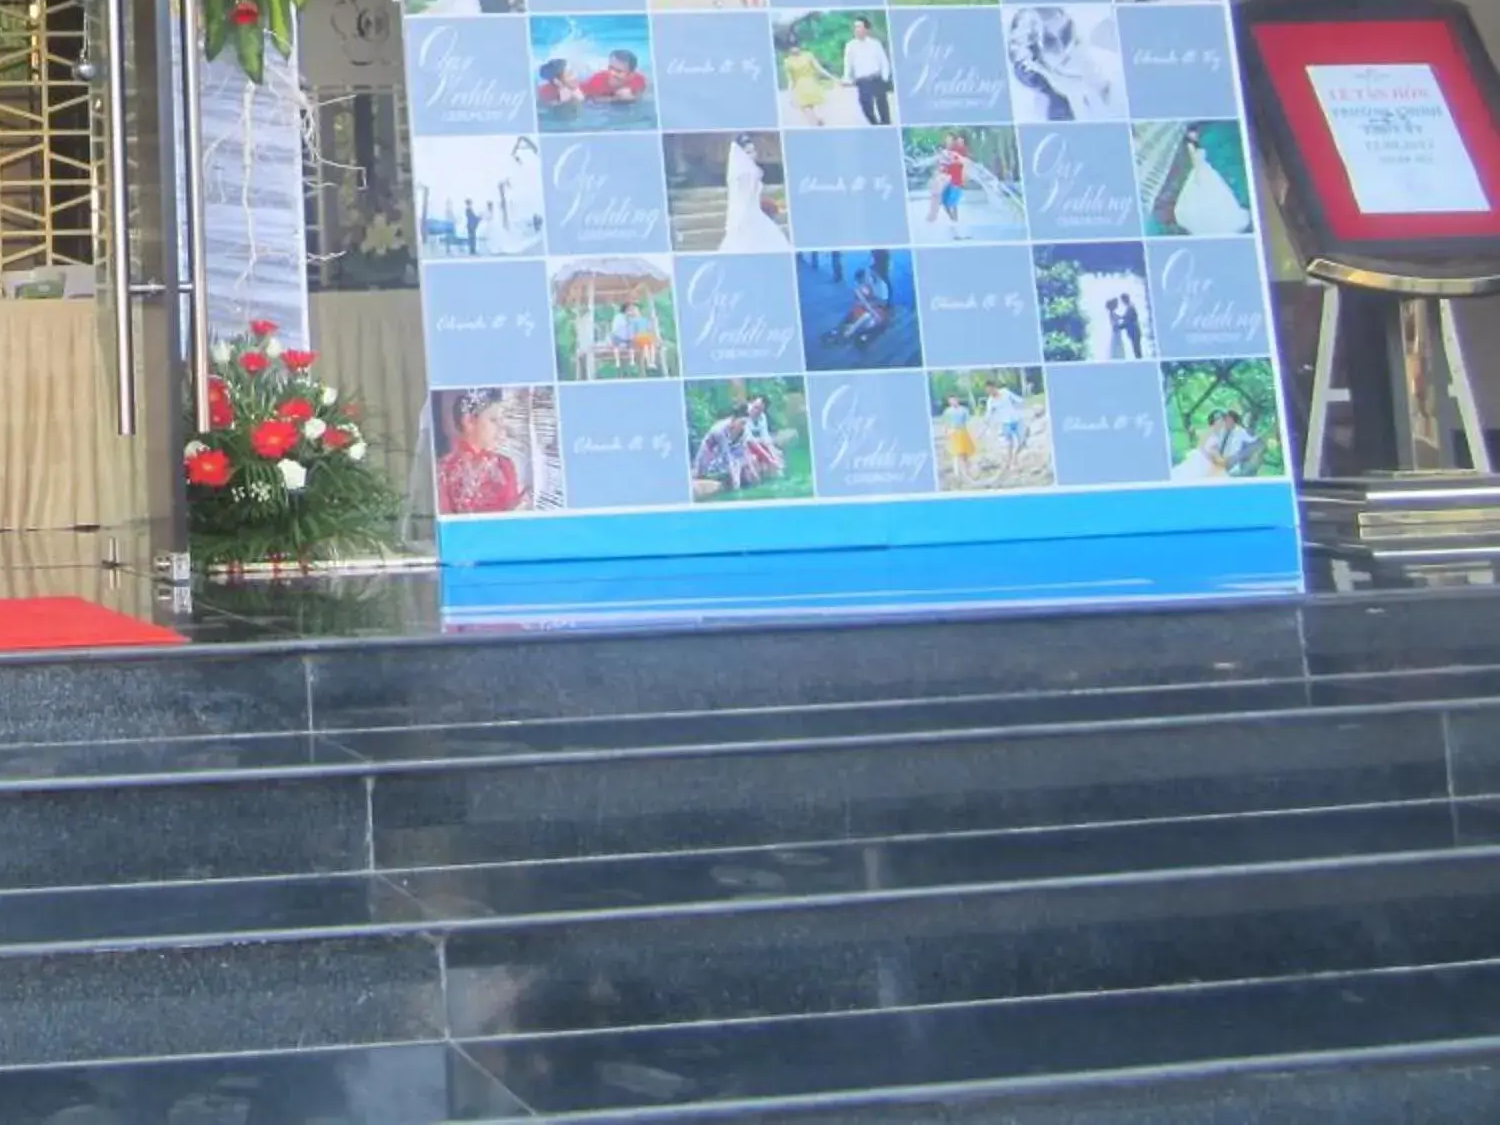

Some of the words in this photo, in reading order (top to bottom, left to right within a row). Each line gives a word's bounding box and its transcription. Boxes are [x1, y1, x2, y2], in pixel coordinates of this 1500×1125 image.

[418, 24, 476, 72] Our
[902, 14, 956, 61] Our
[425, 71, 528, 121] Wedding
[909, 60, 1006, 109] Wedding
[552, 142, 610, 190] Our
[1031, 131, 1085, 178] Our
[559, 190, 662, 240] Wedding
[1039, 177, 1135, 226] Wedding
[686, 259, 744, 309] Our
[1161, 247, 1214, 294] Our
[693, 308, 795, 360] Wedding
[1169, 294, 1263, 343] Wedding
[820, 385, 877, 433] Our
[828, 432, 929, 482] Wedding
